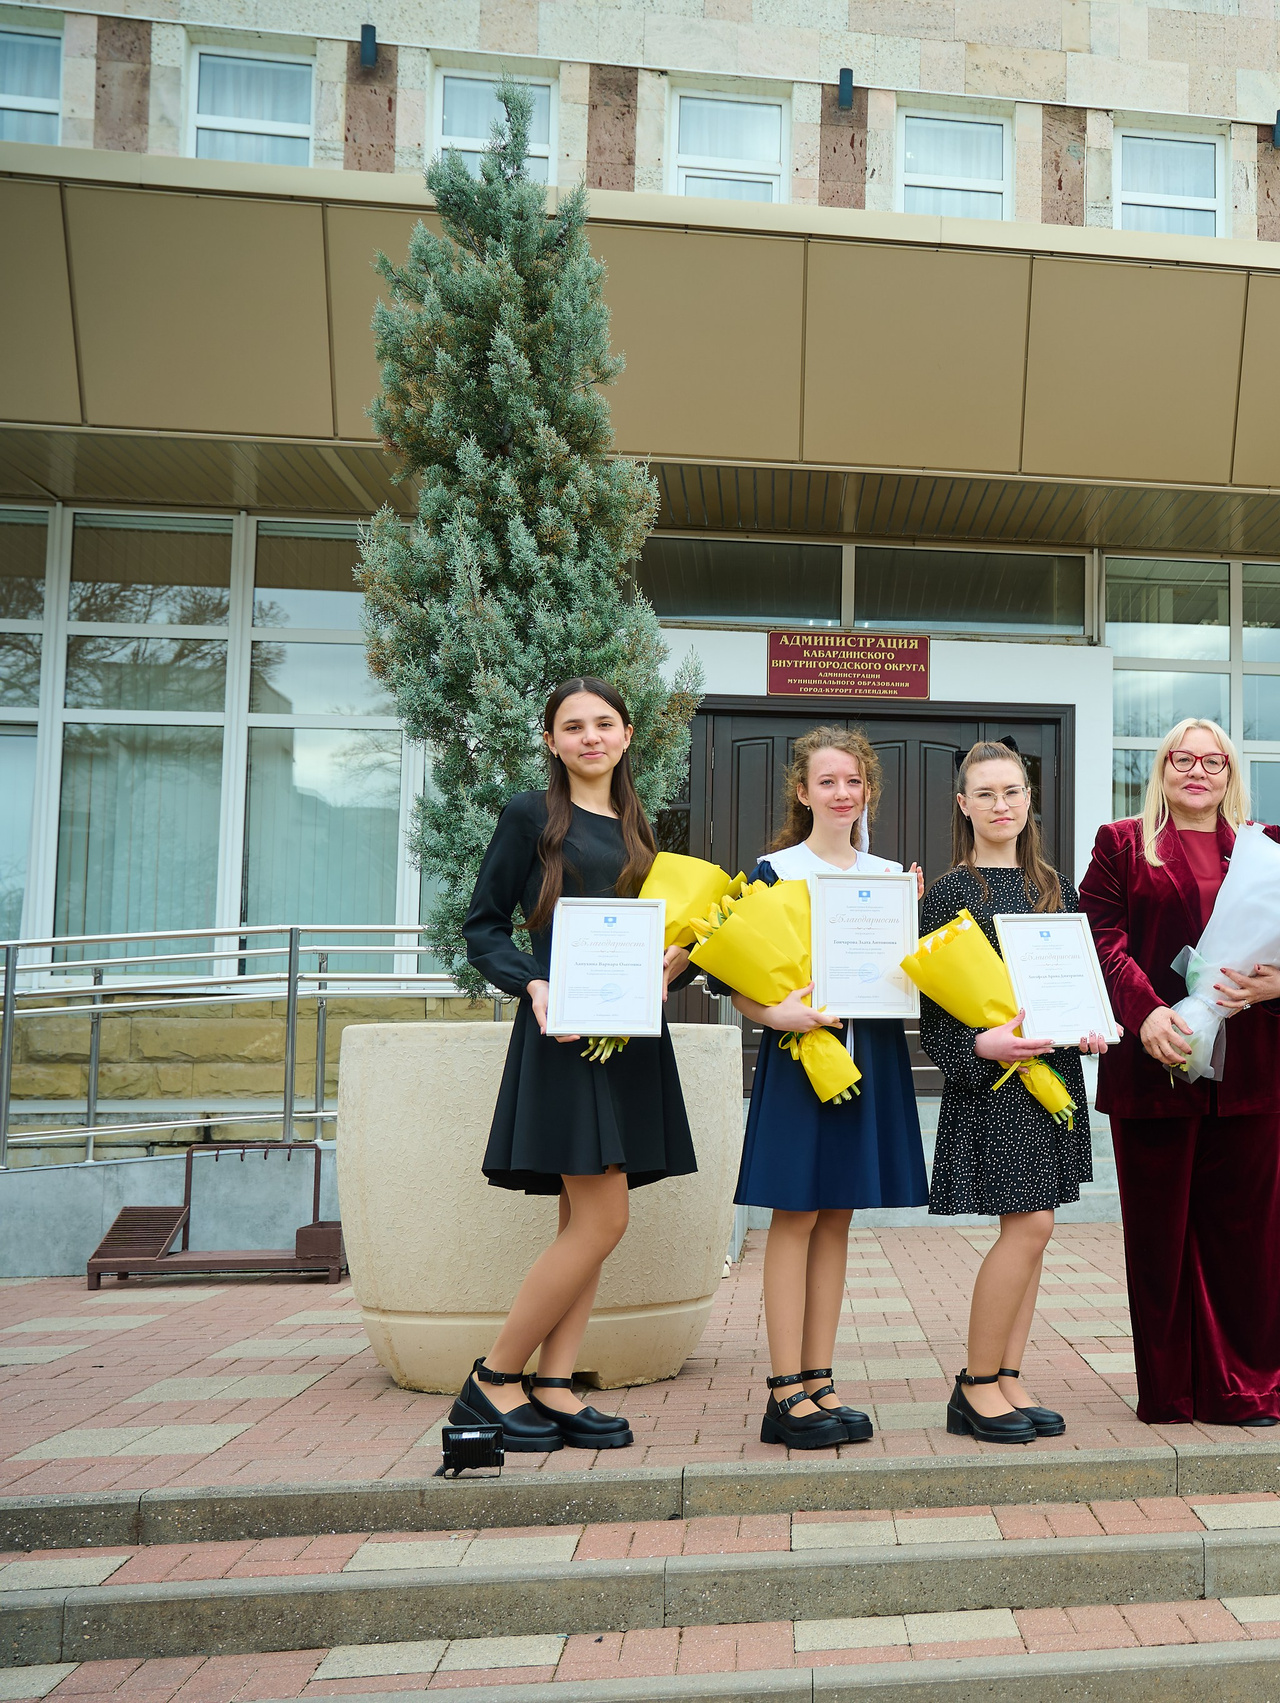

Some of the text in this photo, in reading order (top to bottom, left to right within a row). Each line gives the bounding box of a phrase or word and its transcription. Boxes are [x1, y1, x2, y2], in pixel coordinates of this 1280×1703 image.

[779, 634, 919, 650] АДМИНИСТРАЦИЯ
[803, 649, 895, 660] КАБАРДИНСКОГО
[771, 659, 925, 672] ВНУТРИГОРОДСКОГО ОКРУГА
[787, 678, 855, 686] МУНИЦИПАЛЬНОГО
[829, 914, 900, 927] Благодарность
